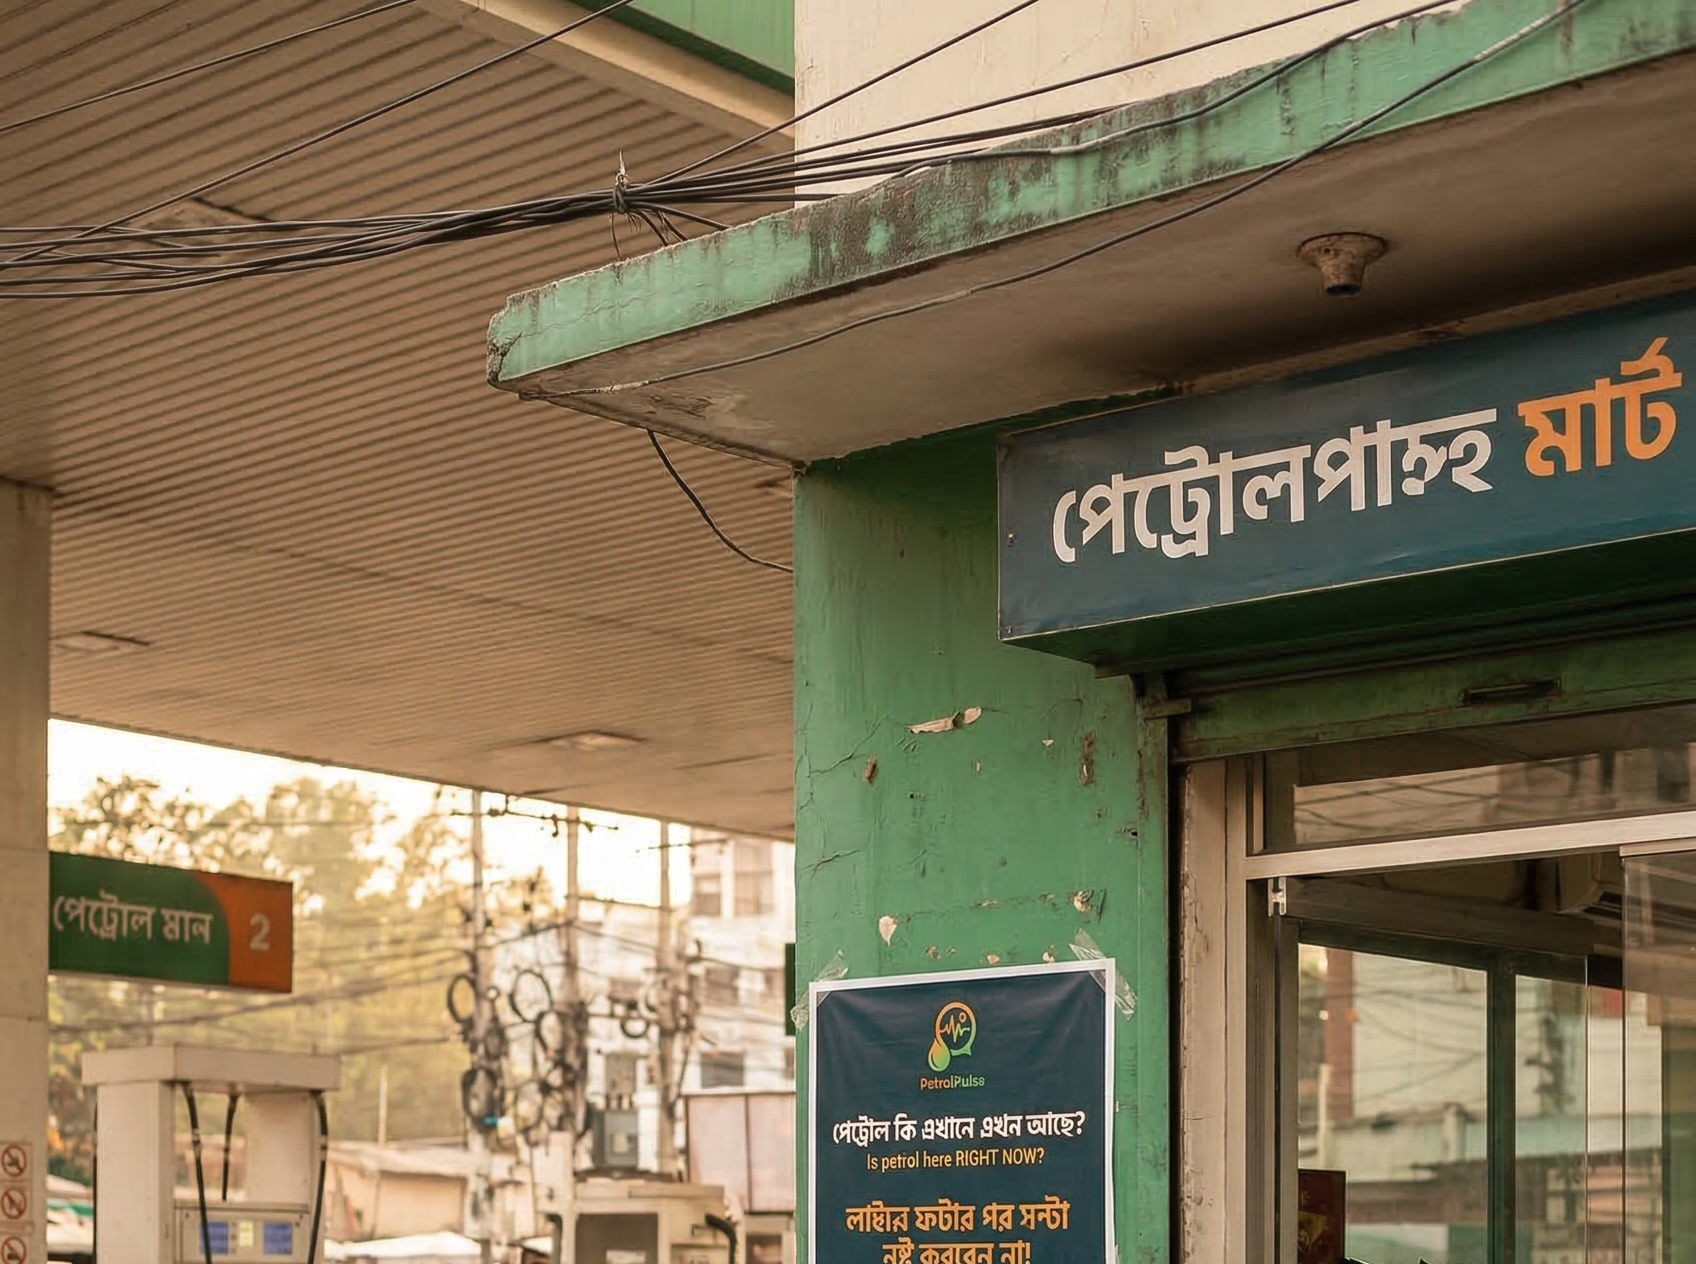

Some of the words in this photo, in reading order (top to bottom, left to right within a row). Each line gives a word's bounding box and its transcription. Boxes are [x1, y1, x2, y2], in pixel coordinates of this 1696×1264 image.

[250, 913, 271, 950] 2
[833, 1114, 891, 1147] পেট্রোল
[893, 1113, 917, 1141] কি
[867, 1154, 878, 1170] Is
[882, 1151, 919, 1173] petrol
[923, 1150, 952, 1167] here
[956, 1149, 999, 1166] RIGHT
[1002, 1147, 1045, 1165] NOW?
